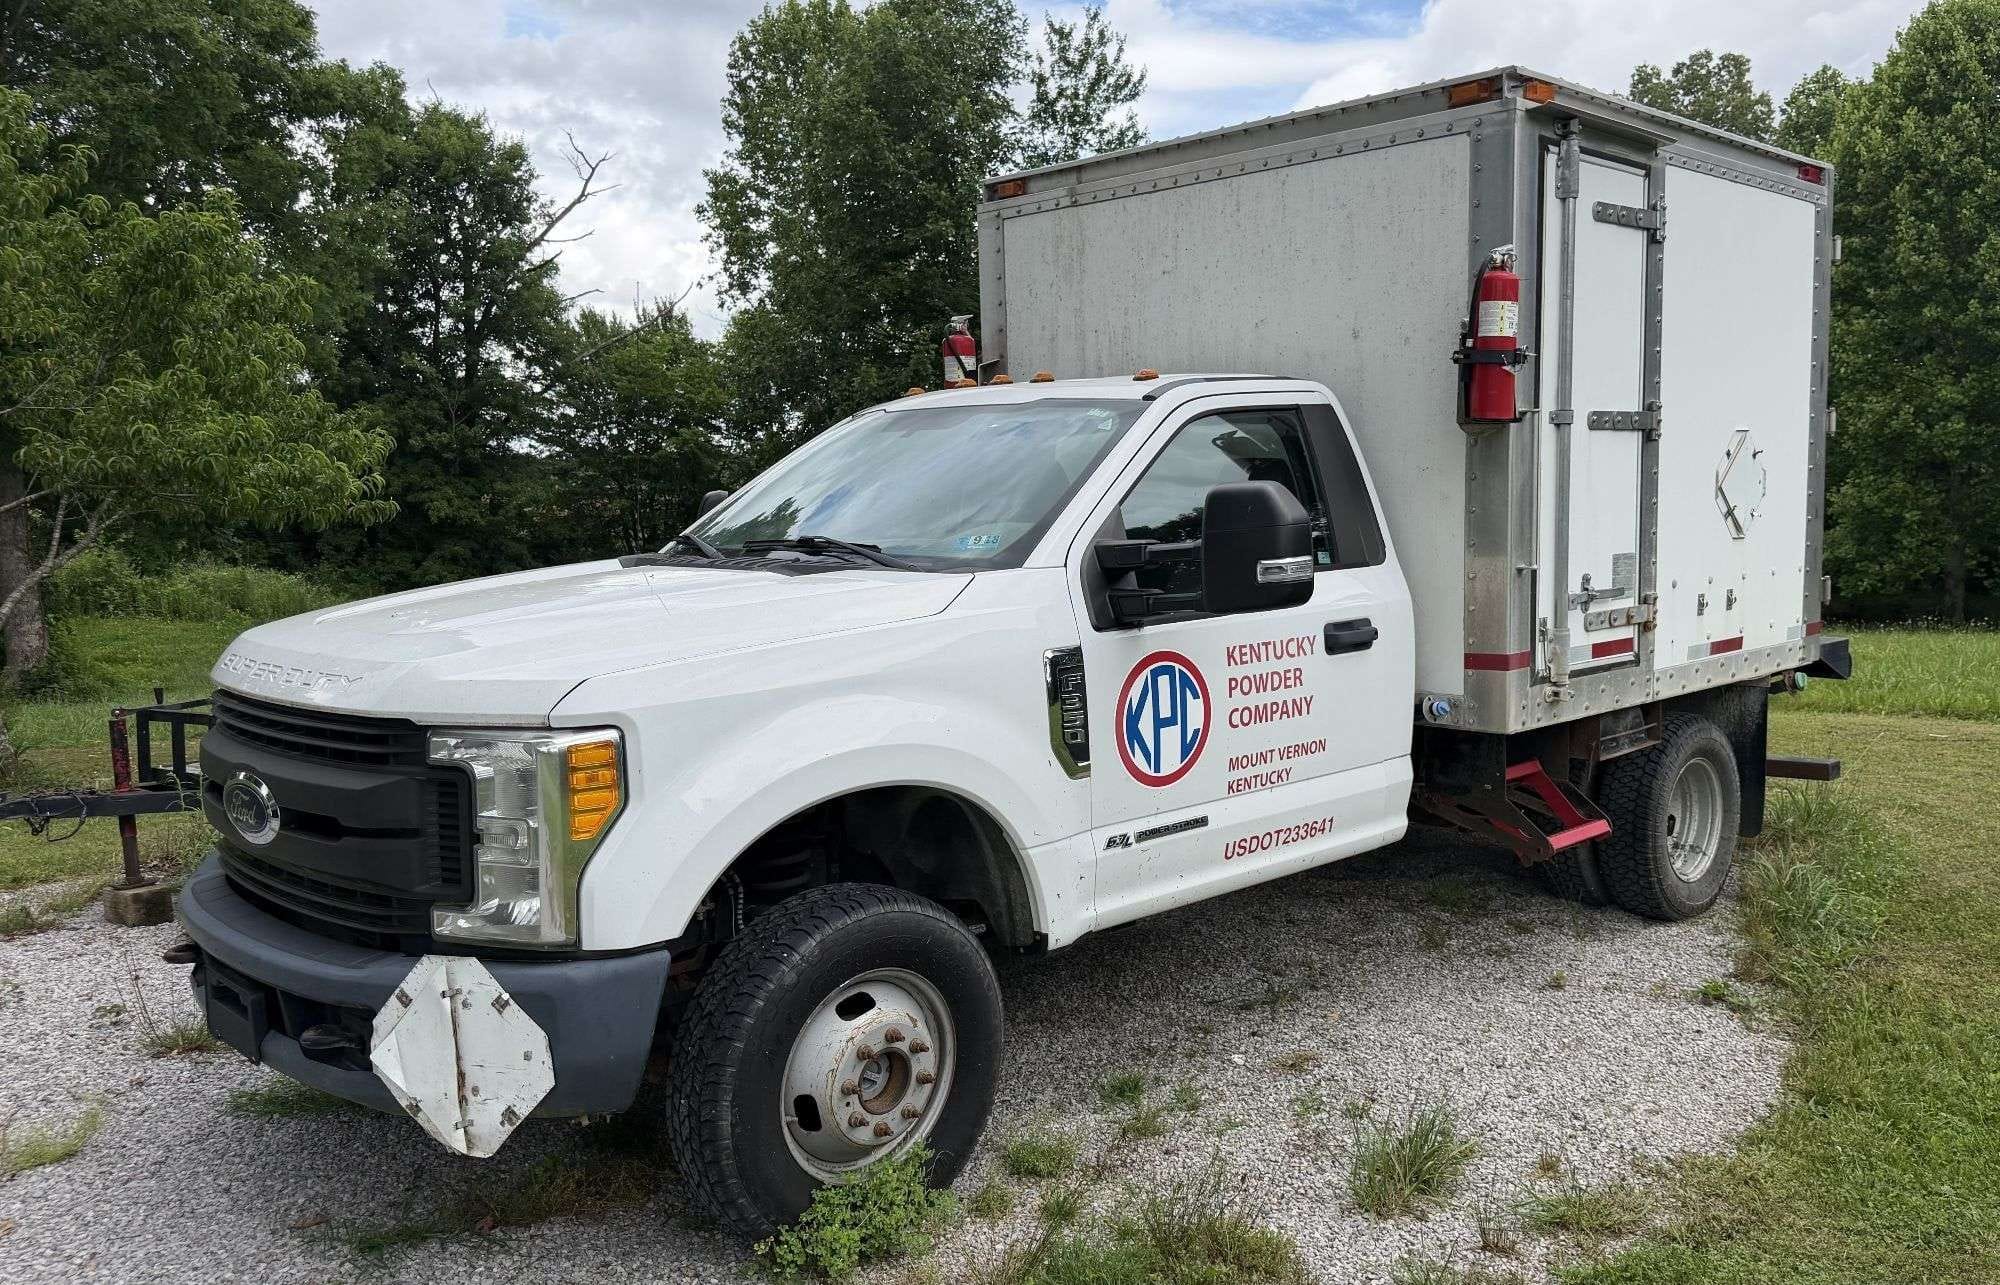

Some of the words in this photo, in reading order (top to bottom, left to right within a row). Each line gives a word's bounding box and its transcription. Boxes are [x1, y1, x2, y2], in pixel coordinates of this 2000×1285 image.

[1226, 634, 1317, 667] KENTUCKY
[220, 653, 283, 682] SUPER
[281, 667, 363, 689] DUTY
[1228, 667, 1304, 699] POWDER
[1125, 664, 1201, 774] KPC
[1228, 695, 1315, 729] COMPANY
[1228, 748, 1276, 773] MOUNT
[1278, 738, 1327, 761] VERNON
[1227, 766, 1293, 795] KENTUCKY
[230, 790, 258, 825] Ford
[1224, 816, 1335, 861] USDOT233641
